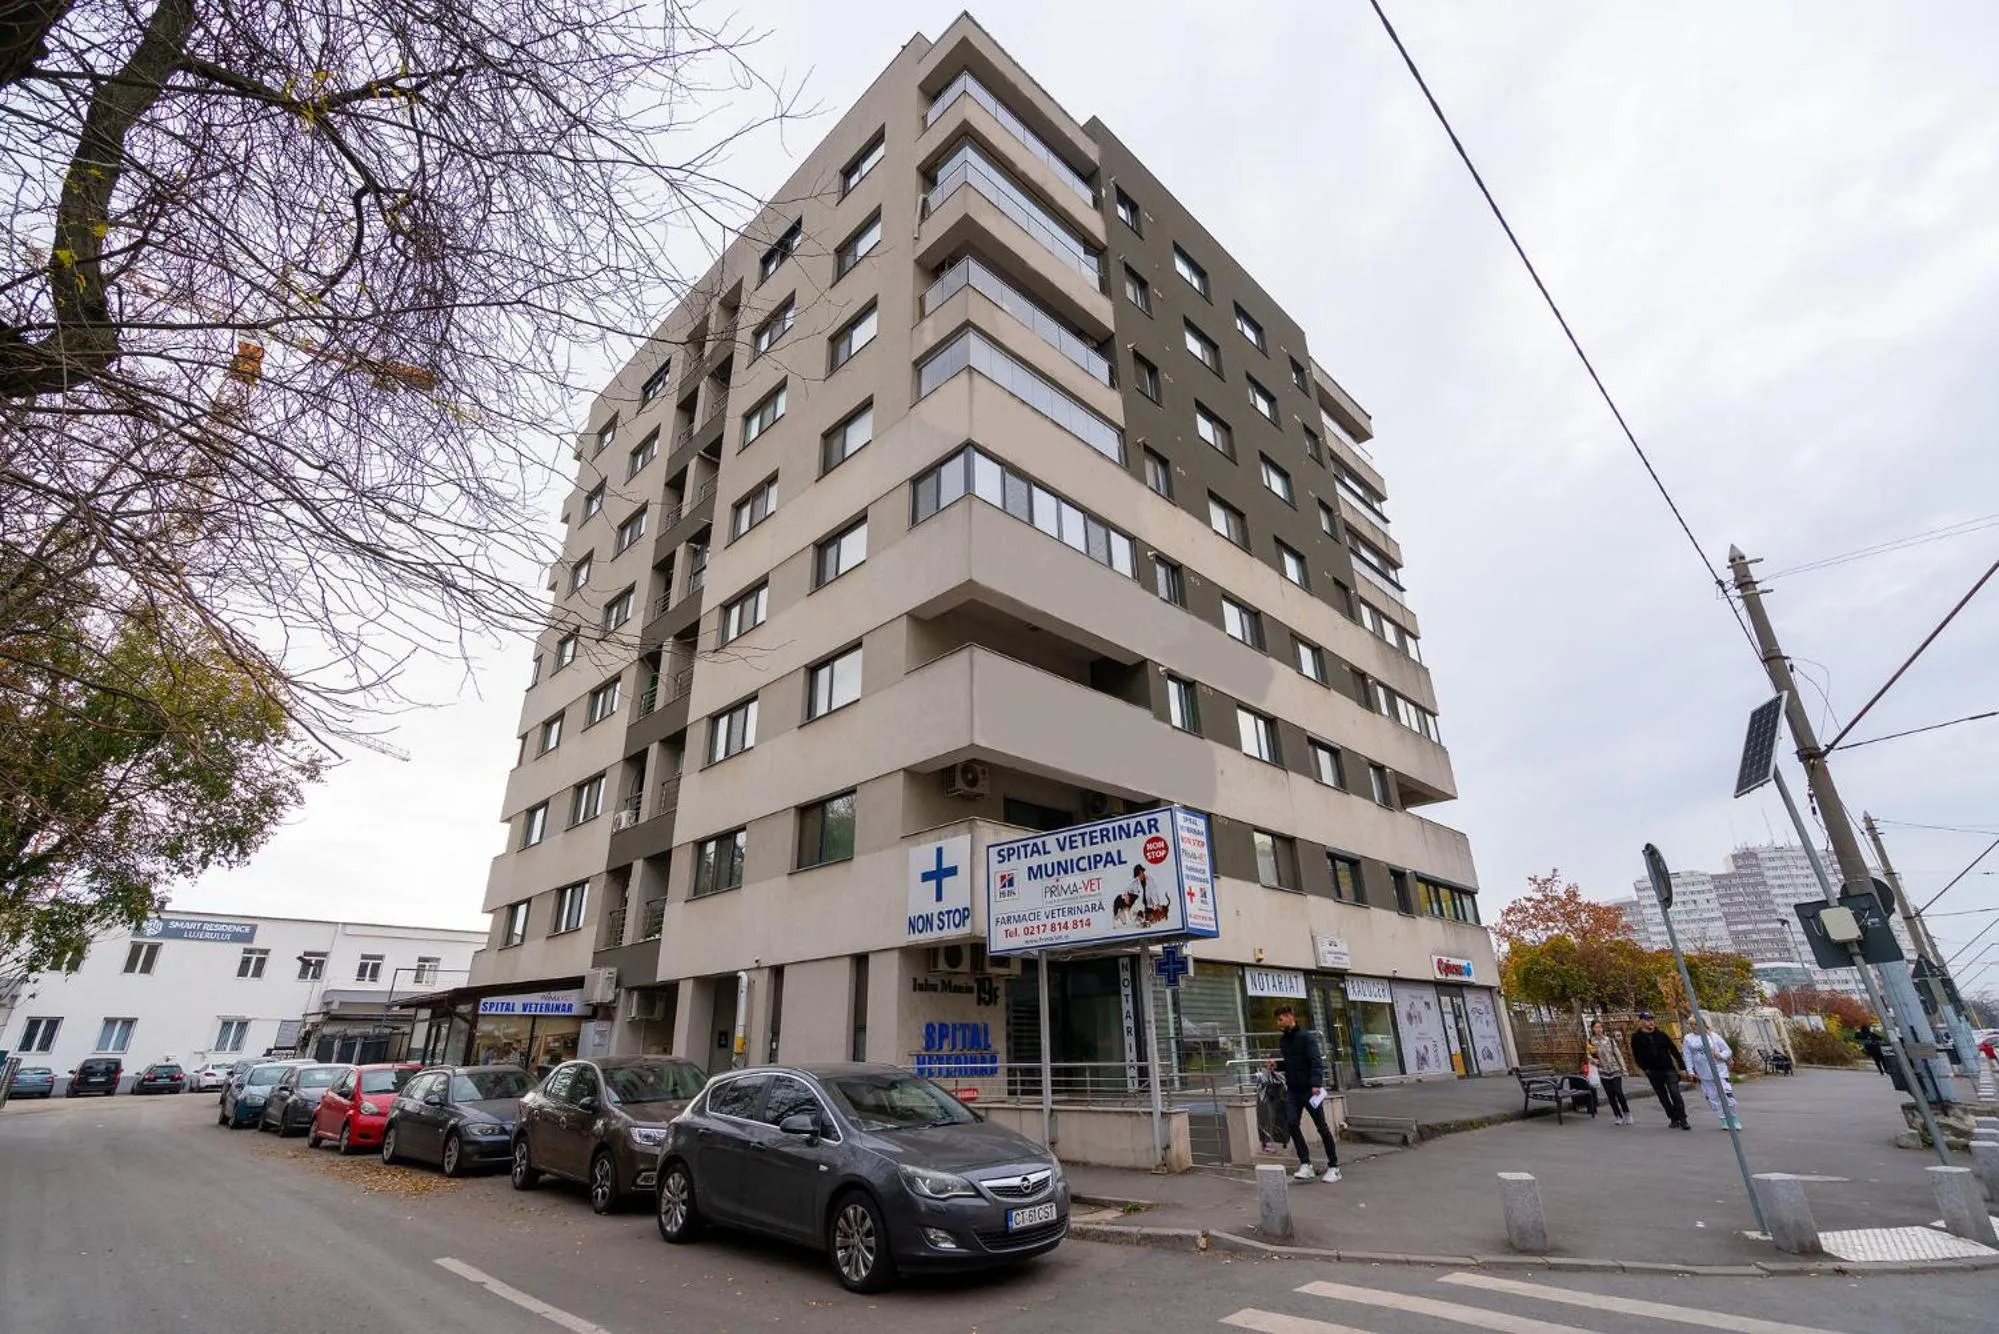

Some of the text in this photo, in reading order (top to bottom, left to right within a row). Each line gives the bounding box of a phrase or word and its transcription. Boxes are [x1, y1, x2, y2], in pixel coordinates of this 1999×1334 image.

[997, 817, 1160, 864] SPITAL VETERINAR
[1146, 841, 1165, 851] NON
[1147, 850, 1166, 861] STOP
[1027, 849, 1127, 881] MUNICIPAL
[168, 920, 251, 934] SMART RESIDENCE
[908, 907, 970, 935] NON STOP
[995, 911, 1041, 926] FARMACIE
[184, 930, 232, 941] LUJERULUI
[1004, 918, 1091, 938] Tel. 0217 814 814
[1249, 972, 1299, 994] NOTARIAT
[481, 1001, 574, 1013] SPITAL VETERINAR
[923, 1022, 992, 1051] SPITAL
